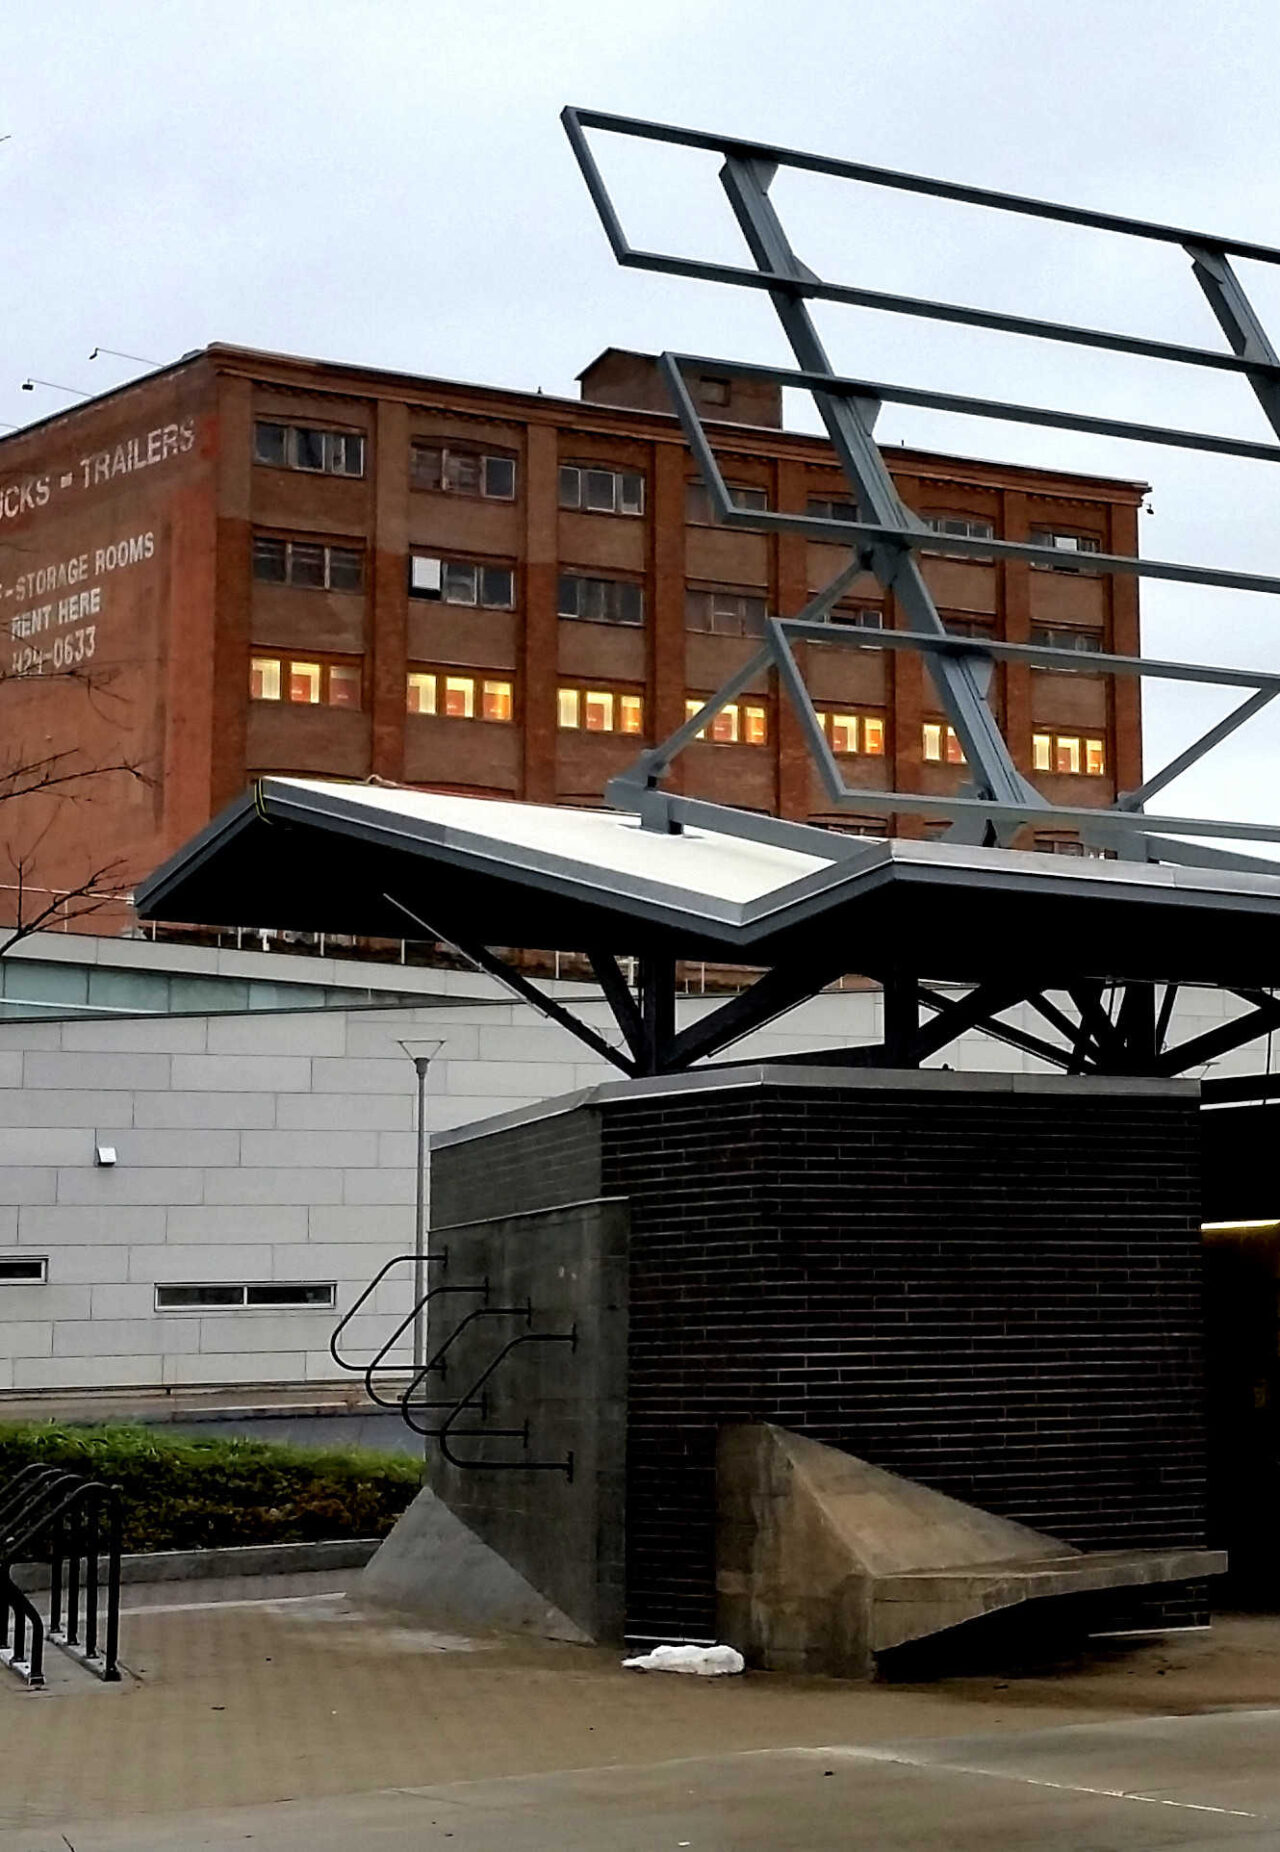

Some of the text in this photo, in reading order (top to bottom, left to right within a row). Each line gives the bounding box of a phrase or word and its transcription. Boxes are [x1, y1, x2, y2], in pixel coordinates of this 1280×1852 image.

[0, 418, 196, 520] CKS TRAILERS
[0, 531, 155, 601] -STORAGE ROOMS
[11, 587, 101, 641] RENT HERE
[12, 625, 96, 678] 424-0633
